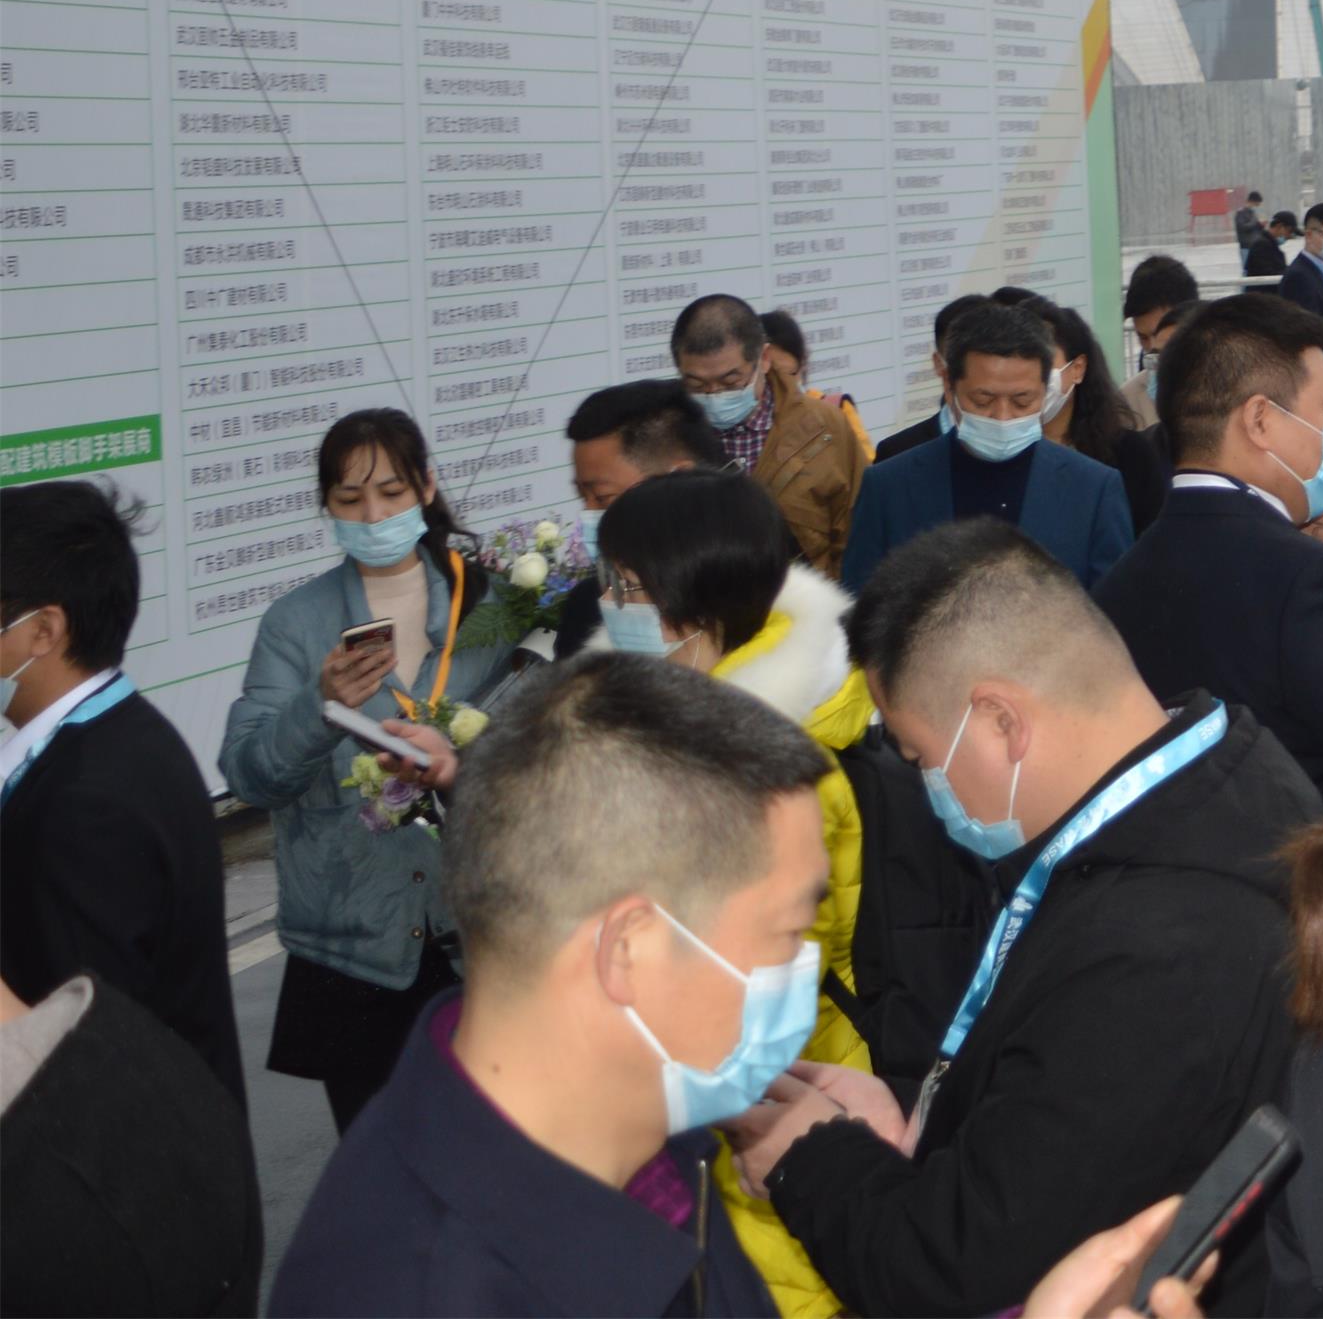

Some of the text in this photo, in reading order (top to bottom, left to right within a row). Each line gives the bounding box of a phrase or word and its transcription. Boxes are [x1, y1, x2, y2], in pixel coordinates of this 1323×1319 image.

[0, 205, 67, 229] 技有限公司
